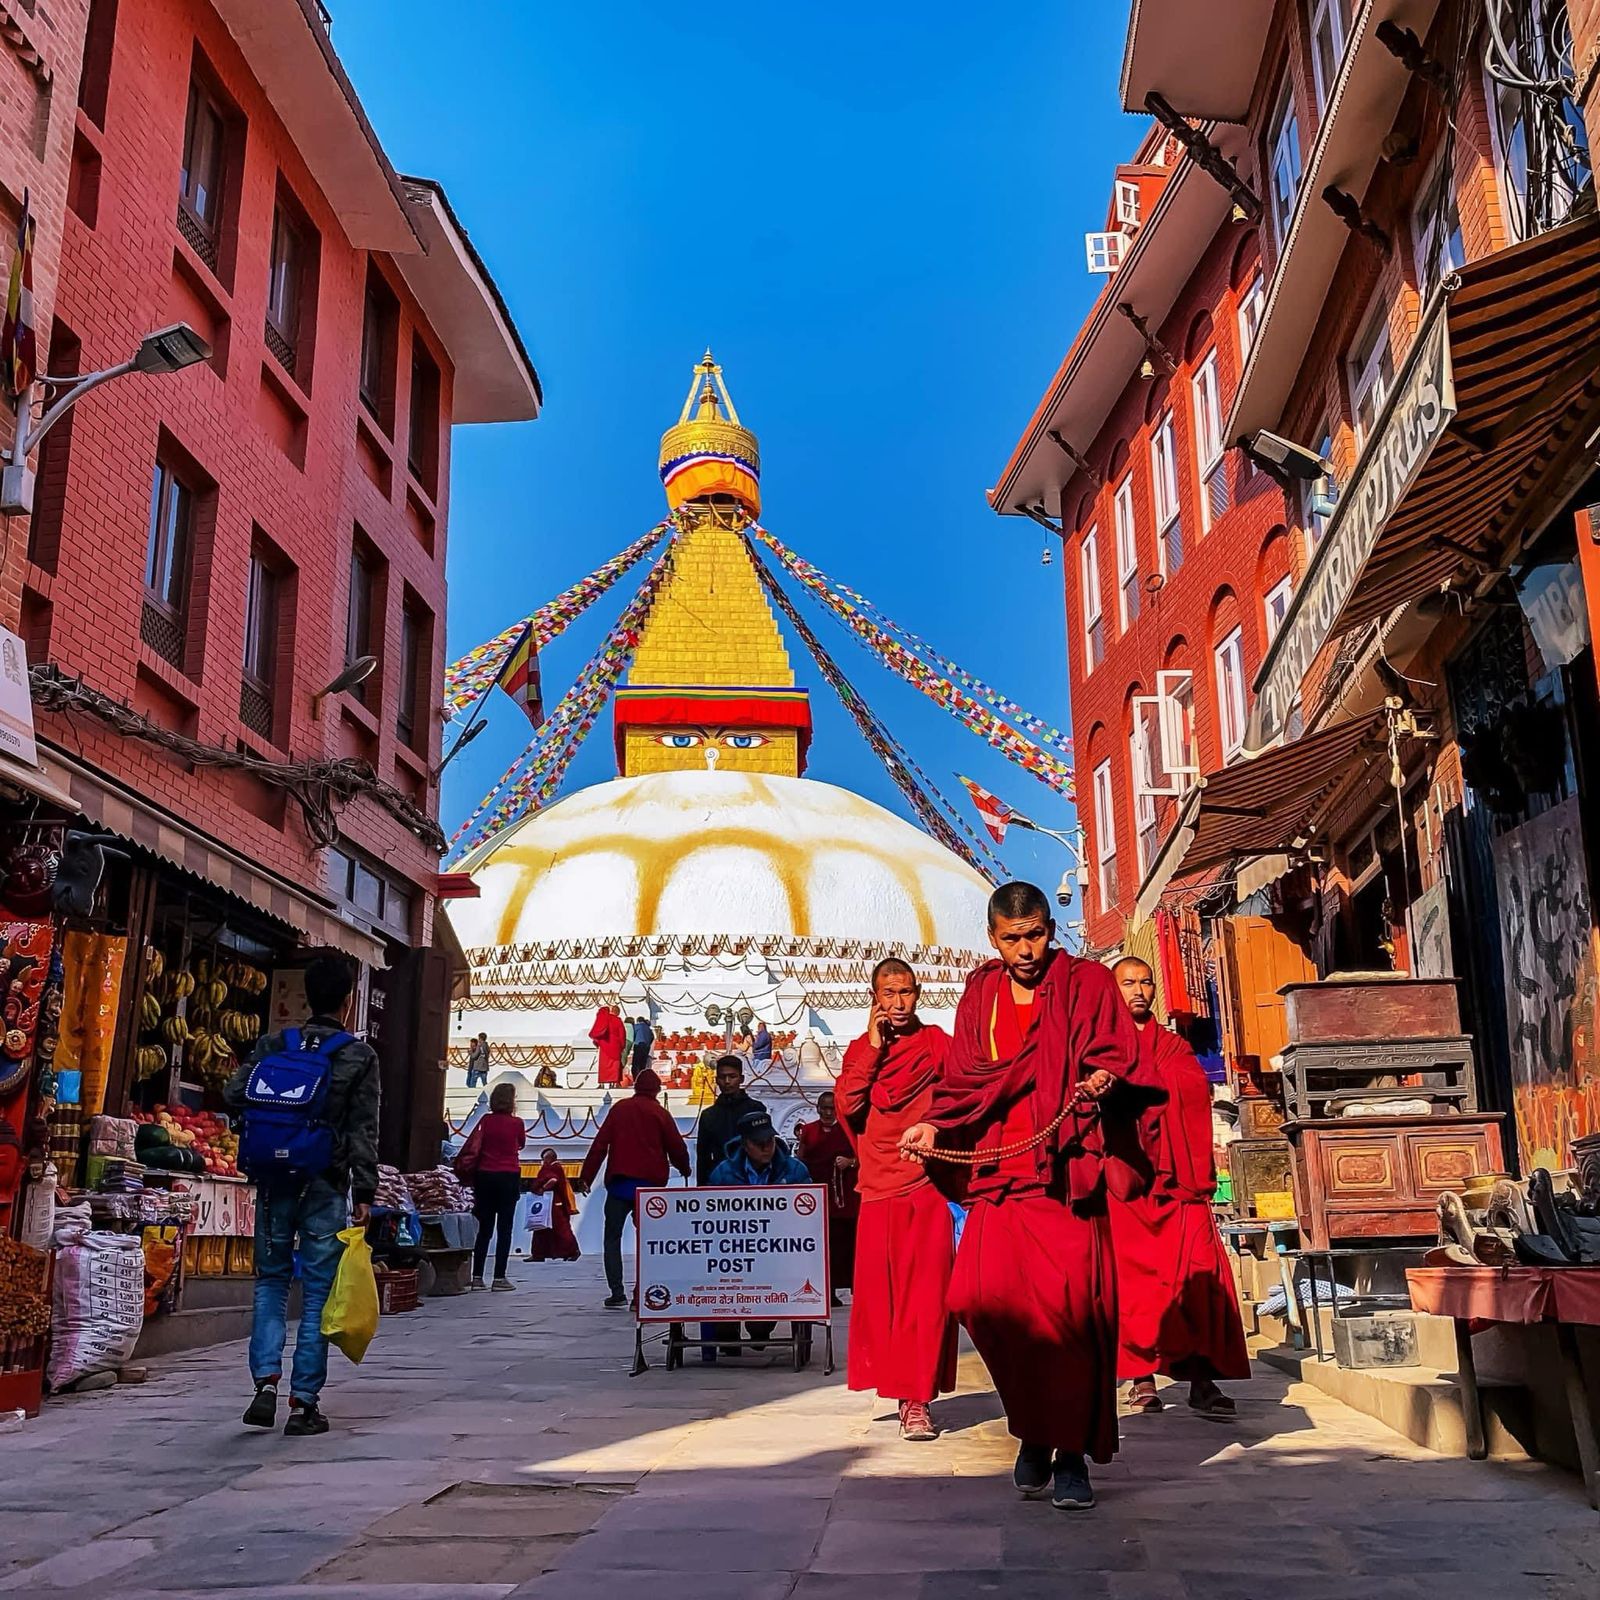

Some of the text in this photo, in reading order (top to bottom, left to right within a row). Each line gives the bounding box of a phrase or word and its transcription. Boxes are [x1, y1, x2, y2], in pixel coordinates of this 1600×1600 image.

[1308, 356, 1441, 654] FURNITURES
[675, 1197, 788, 1213] NO SMOKING
[691, 1219, 771, 1235] TOURIST
[647, 1238, 816, 1255] TICKET CHECKING
[707, 1258, 755, 1273] POST
[736, 1292, 761, 1304] विकास
[764, 1292, 788, 1304] समिति
